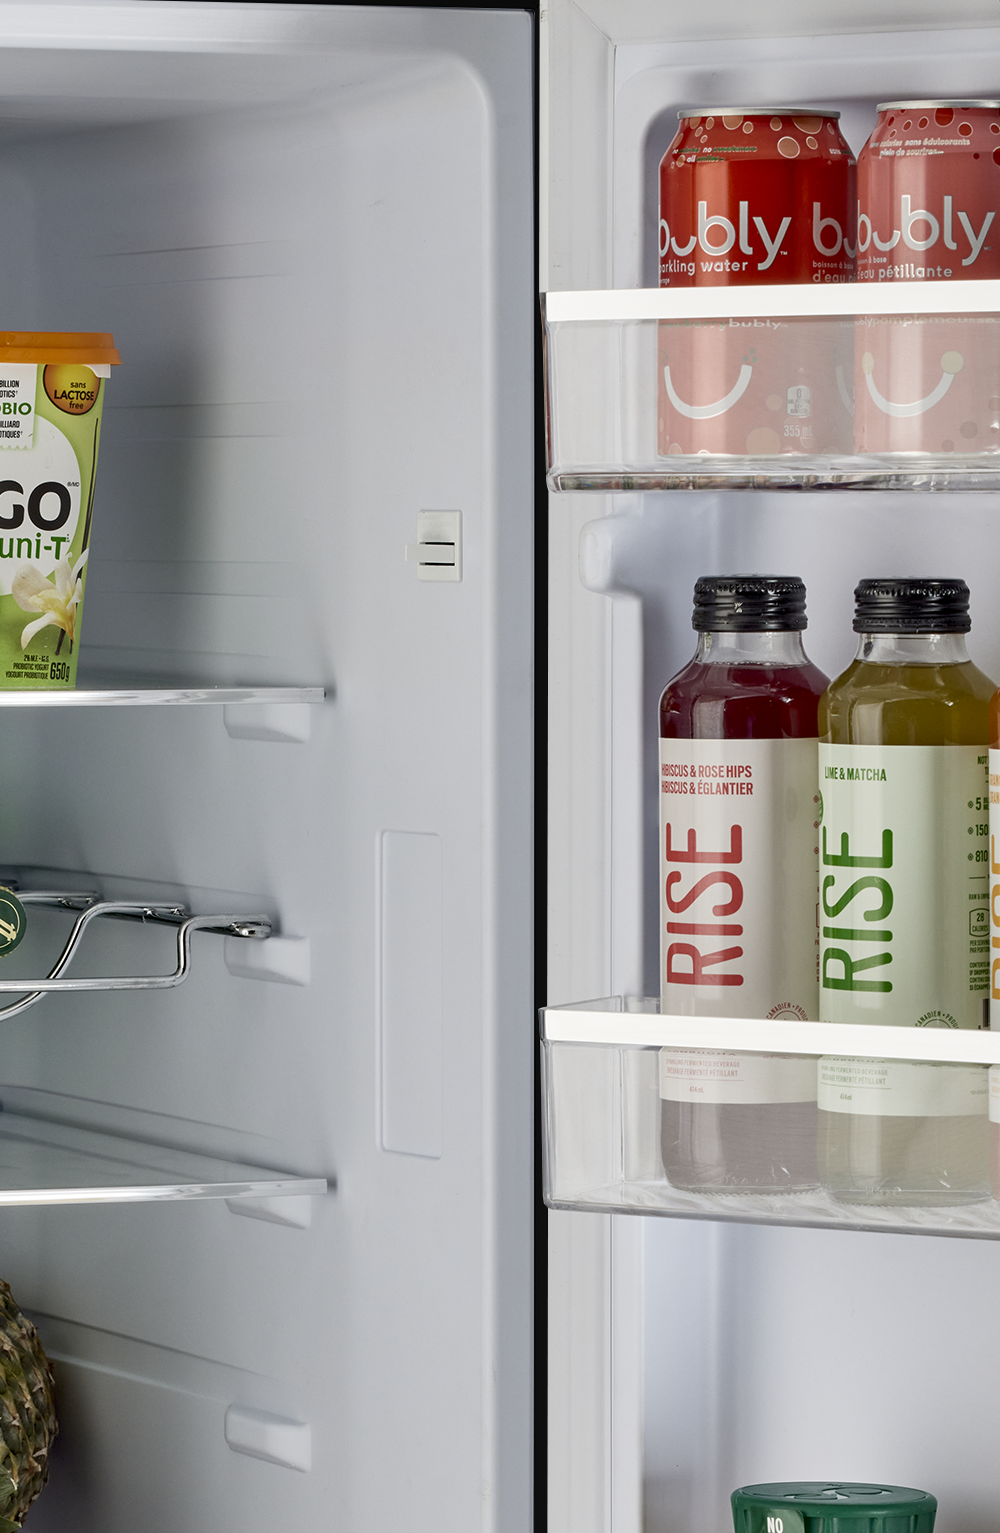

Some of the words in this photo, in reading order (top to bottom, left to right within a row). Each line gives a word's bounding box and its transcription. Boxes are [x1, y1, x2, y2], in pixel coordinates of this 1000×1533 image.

[659, 200, 792, 271] bubly
[858, 194, 996, 267] bubly
[700, 260, 748, 273] water
[812, 261, 837, 269] boisson
[812, 270, 846, 283] d'eau
[878, 263, 953, 281] pétillante
[0, 380, 19, 388] BILLION
[54, 390, 94, 400] LACTOSE
[69, 401, 84, 409] free
[661, 764, 688, 777] HIBISCUS
[689, 765, 697, 778] &
[698, 765, 725, 778] ROSE
[726, 765, 752, 778] HIPS
[824, 767, 838, 780] LIME
[839, 767, 846, 780] &
[846, 767, 887, 782] MATCHA
[661, 780, 688, 794] HIBISCUS
[689, 782, 696, 795] &
[697, 780, 754, 795] ÉGLANTIER
[975, 797, 982, 811] 5
[976, 824, 988, 836] 150
[975, 850, 988, 863] 810
[666, 822, 744, 986] RISE
[822, 826, 894, 993] RISE
[976, 913, 985, 922] 28
[713, 1060, 741, 1068] BEVERAGE
[709, 1067, 738, 1077] PÉTILLANT
[861, 1068, 889, 1076] BEVERAGE
[857, 1074, 886, 1085] PÉTILLANT
[767, 1517, 783, 1533] NO
